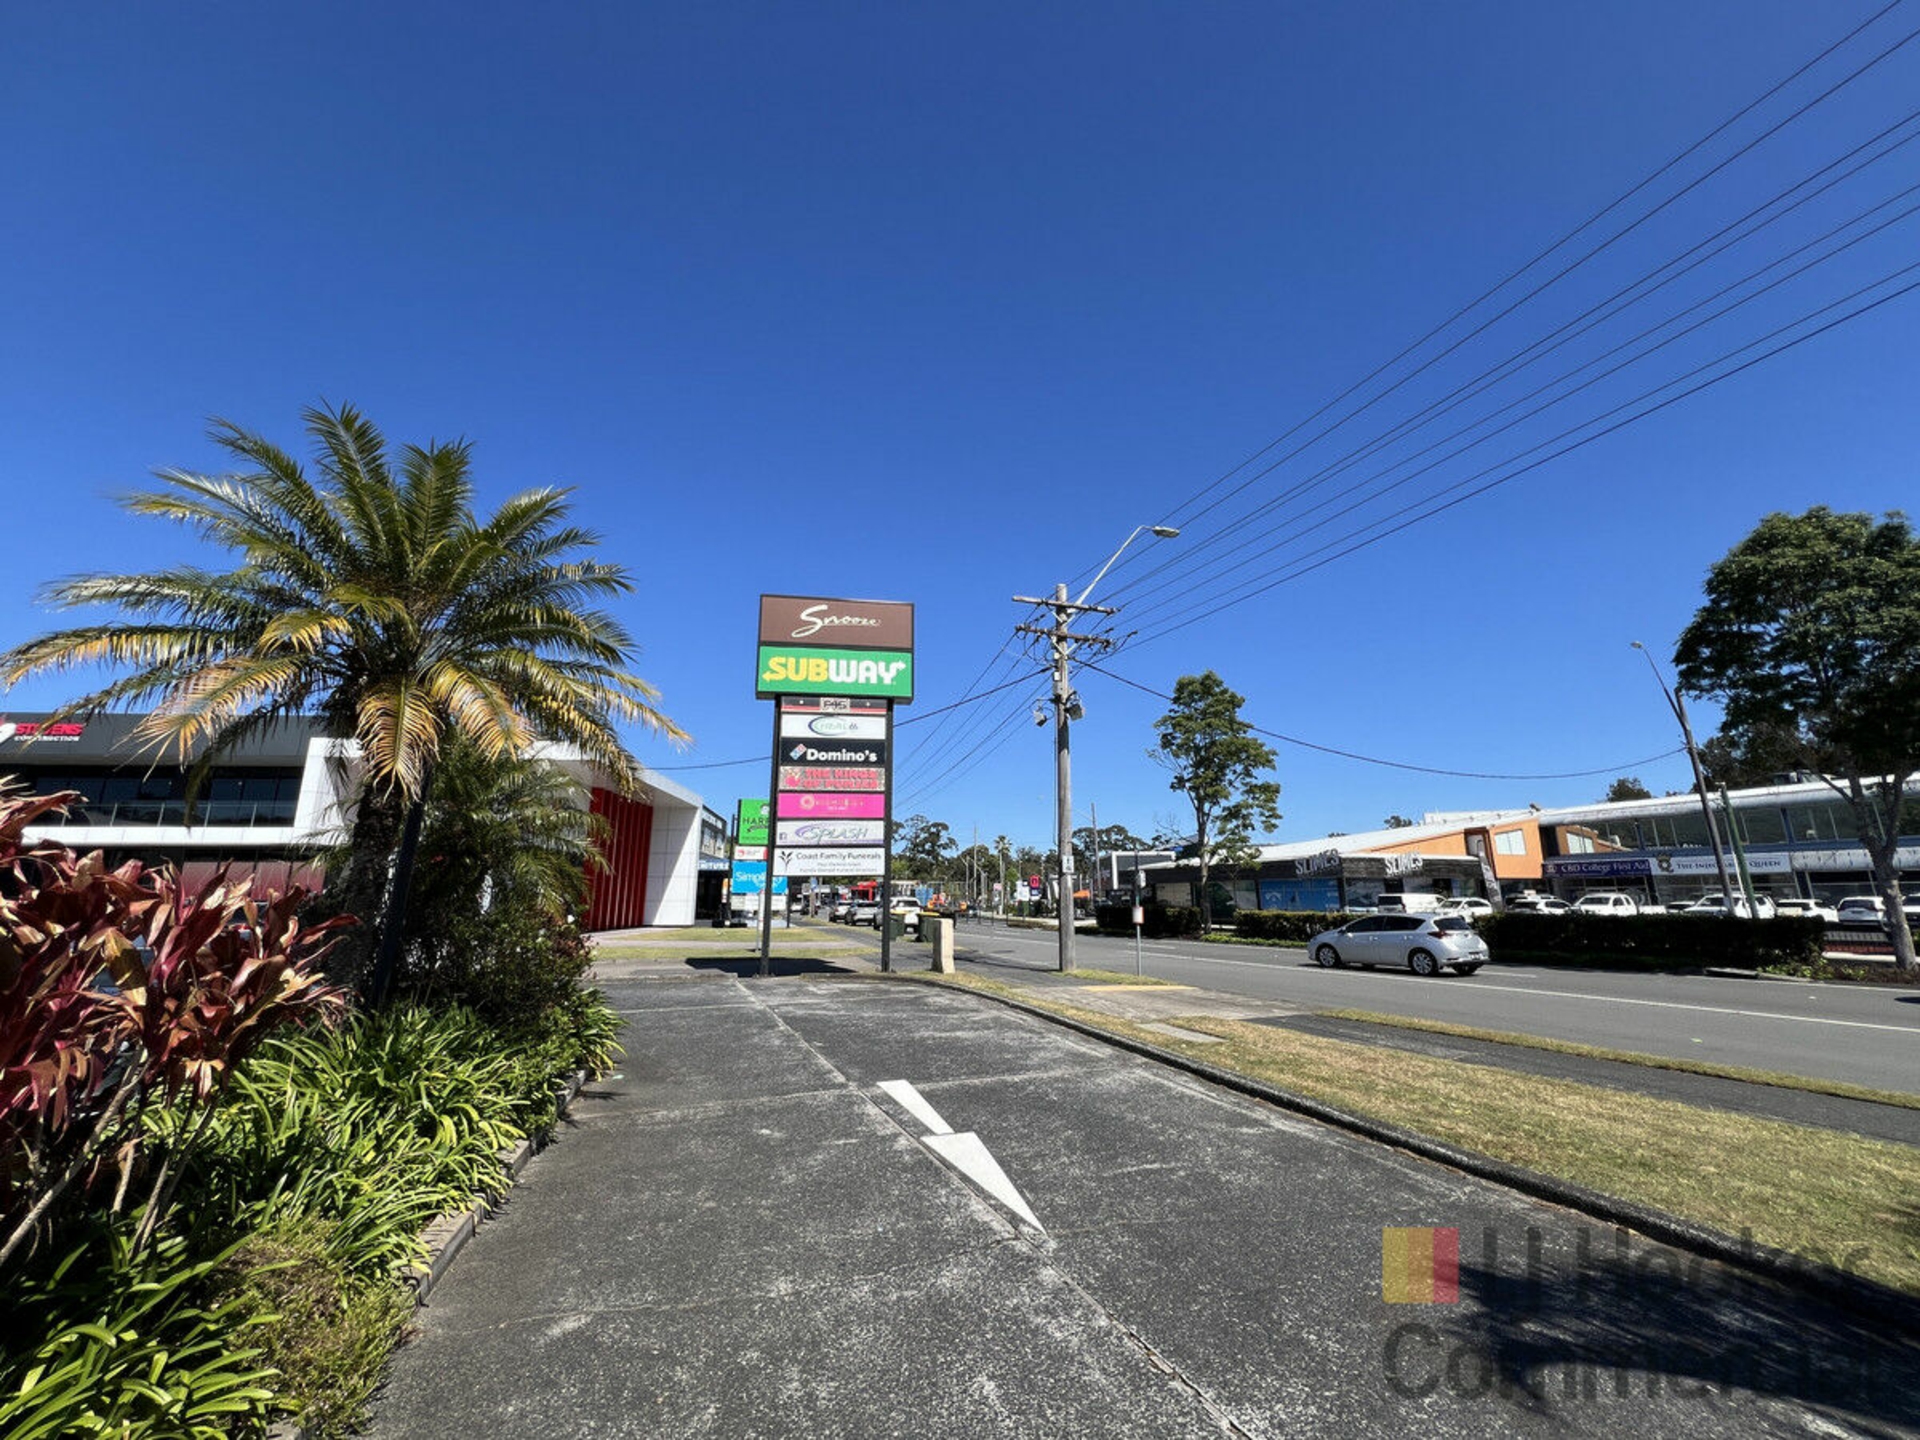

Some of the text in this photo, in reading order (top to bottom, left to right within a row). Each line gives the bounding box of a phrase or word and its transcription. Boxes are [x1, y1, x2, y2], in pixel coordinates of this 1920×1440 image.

[791, 604, 880, 638] Snooze
[762, 656, 906, 685] SUBWAY
[823, 700, 847, 710] F45
[15, 722, 83, 735] STVENS
[806, 748, 878, 762] Domino's
[797, 852, 882, 862] Coast Family Funerals
[1561, 865, 1580, 873] CBD
[1582, 863, 1610, 873] College
